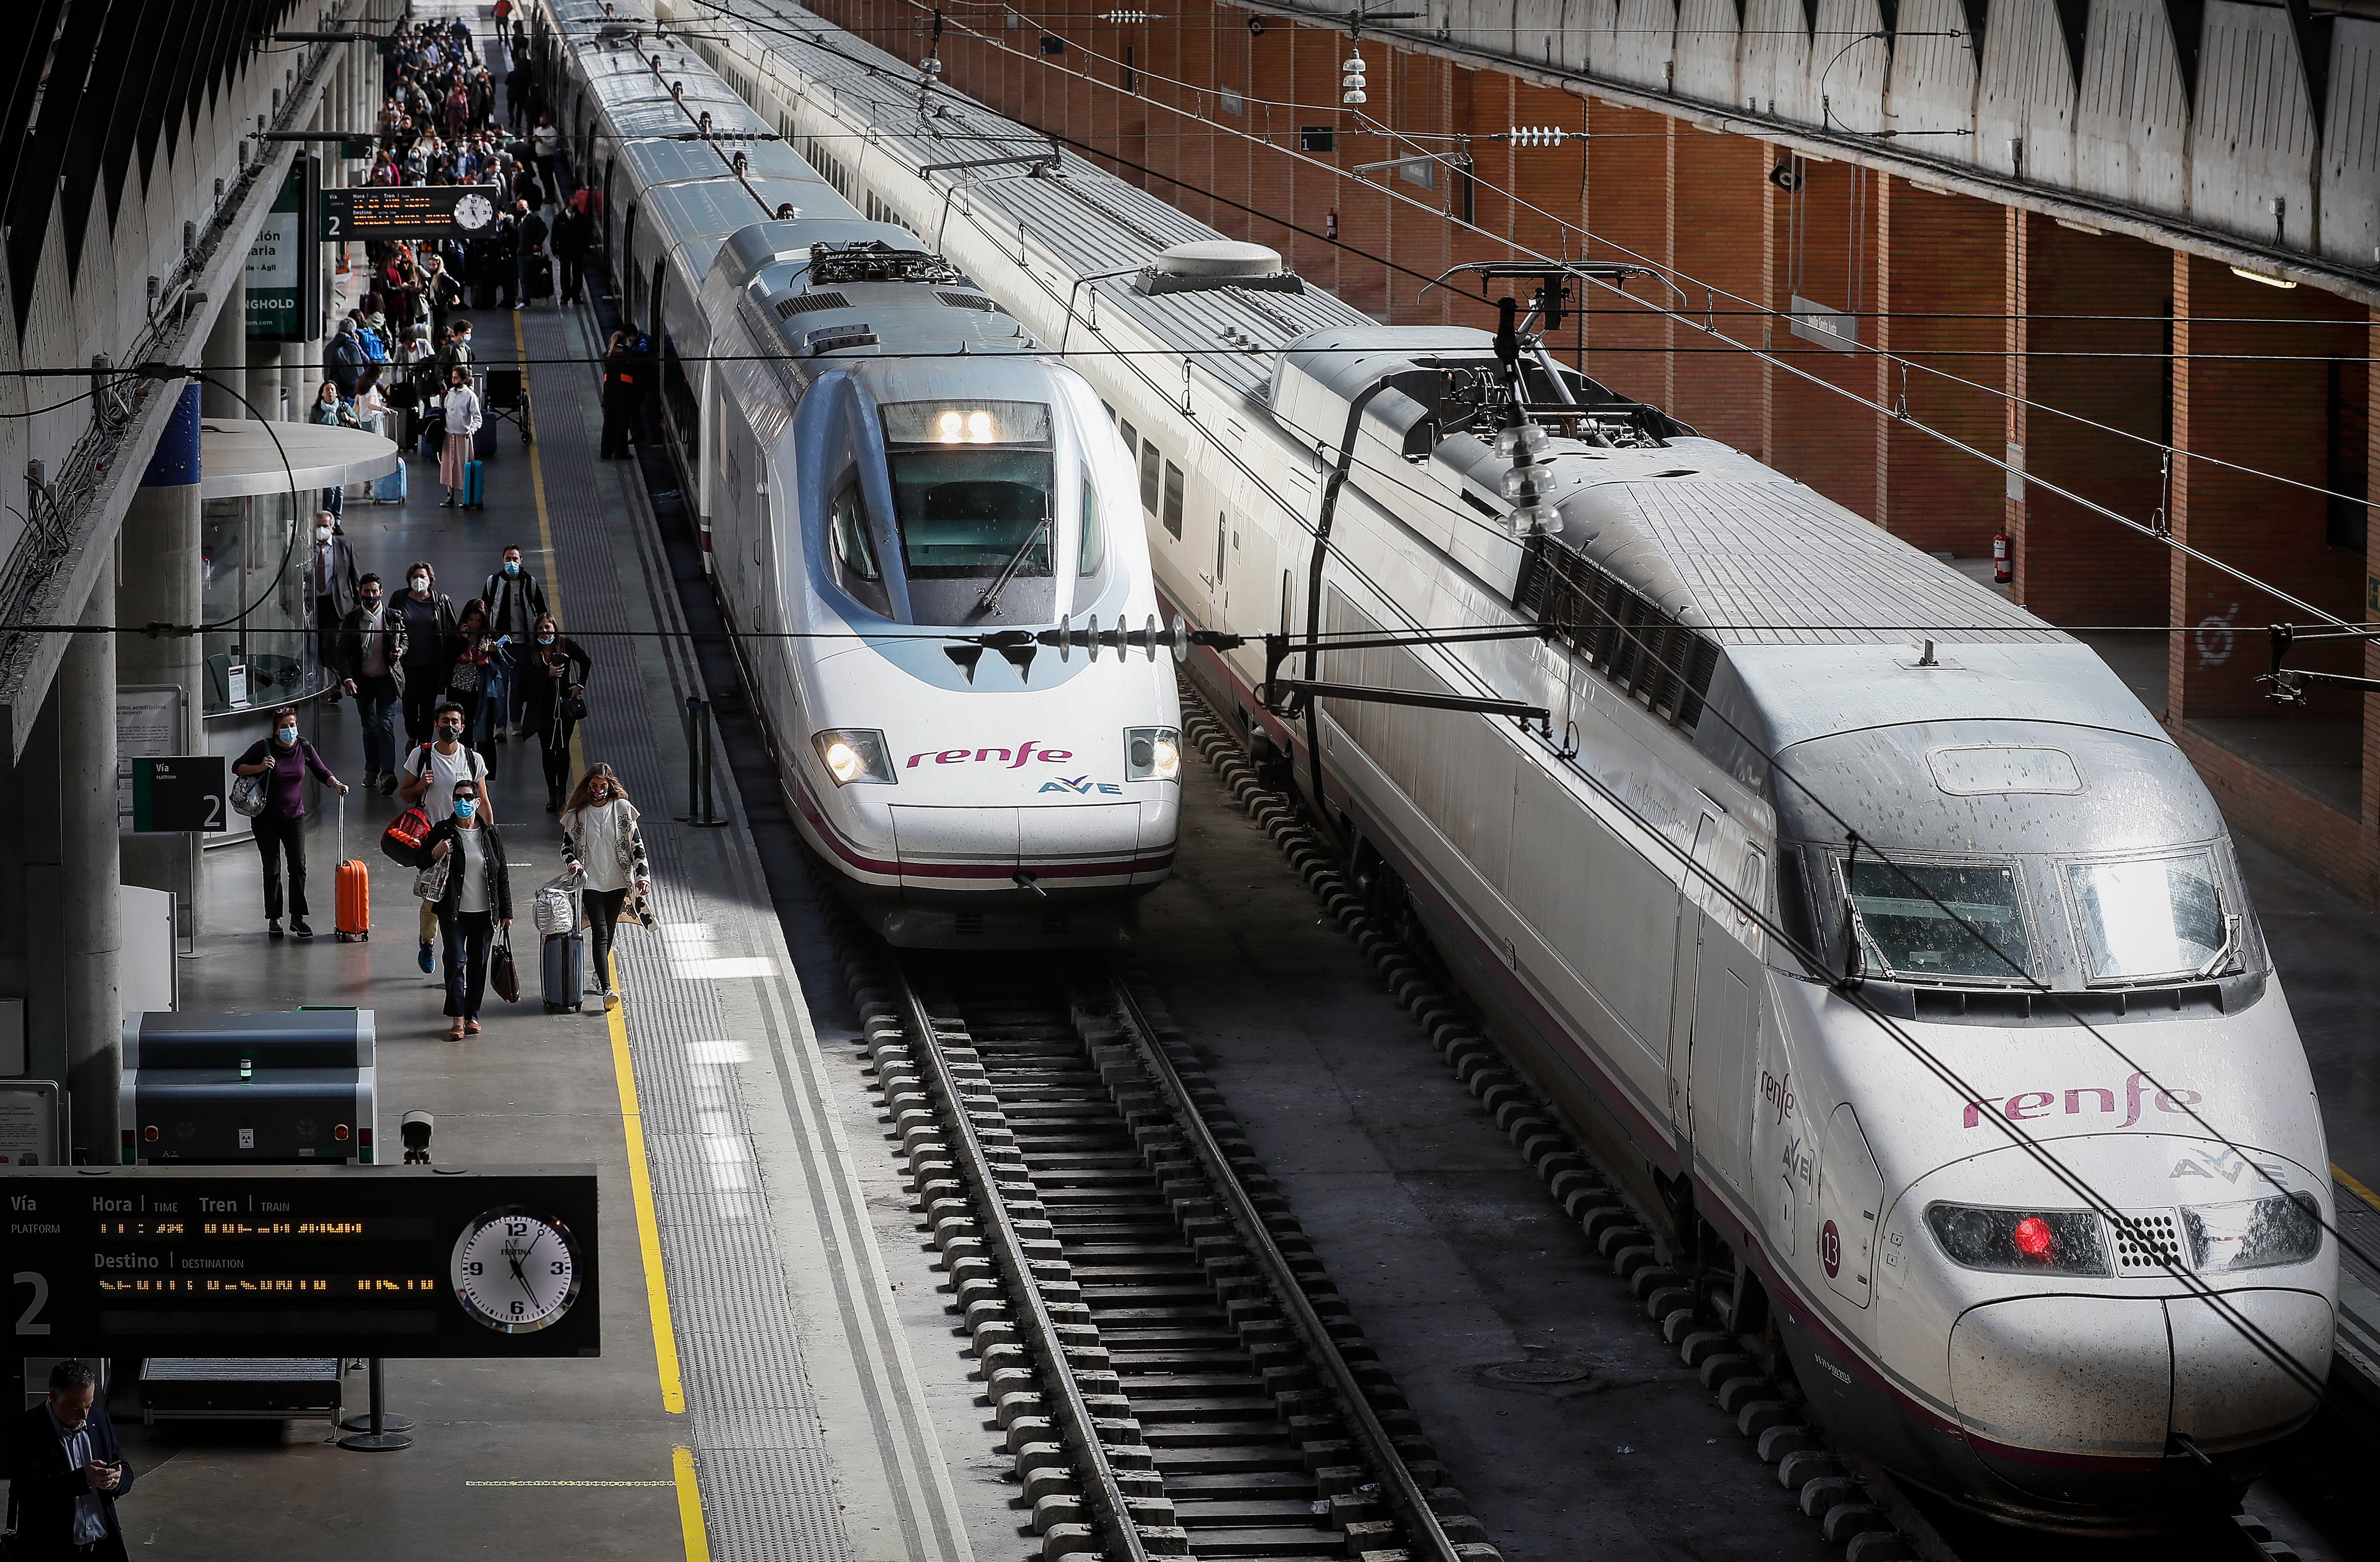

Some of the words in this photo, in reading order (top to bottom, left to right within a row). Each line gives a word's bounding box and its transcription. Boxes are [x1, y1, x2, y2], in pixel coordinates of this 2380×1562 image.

[365, 146, 371, 158] 2
[1302, 138, 1309, 150] 1
[329, 216, 340, 236] 2
[248, 245, 276, 256] aria
[261, 263, 276, 272] Ágil
[906, 741, 1073, 770] renfe
[156, 763, 169, 772] Vía
[1037, 776, 1123, 795] AVE
[203, 795, 220, 827] 2
[1625, 772, 1641, 809] Juan
[1638, 784, 1668, 833] Sebastián
[1666, 807, 1688, 850] Elcano
[1761, 1071, 1794, 1125] renfe
[1963, 1071, 2202, 1129] renfe
[1782, 1136, 1808, 1181] AVE
[2169, 1148, 2289, 1186] AVE
[11, 1195, 36, 1211] Vía
[93, 1196, 132, 1211] Hora
[153, 1203, 178, 1212] TIME
[199, 1197, 237, 1212] Tren
[261, 1202, 290, 1212] TRAIN
[11, 1224, 60, 1234] PLATFORM
[505, 1223, 527, 1237] 12
[1824, 1232, 1838, 1266] 13
[95, 1253, 159, 1268] Destino
[182, 1259, 244, 1268] DESTINATION
[469, 1262, 483, 1275] 9
[550, 1261, 564, 1275] 3
[13, 1271, 51, 1335] 2
[510, 1301, 524, 1315] 6
